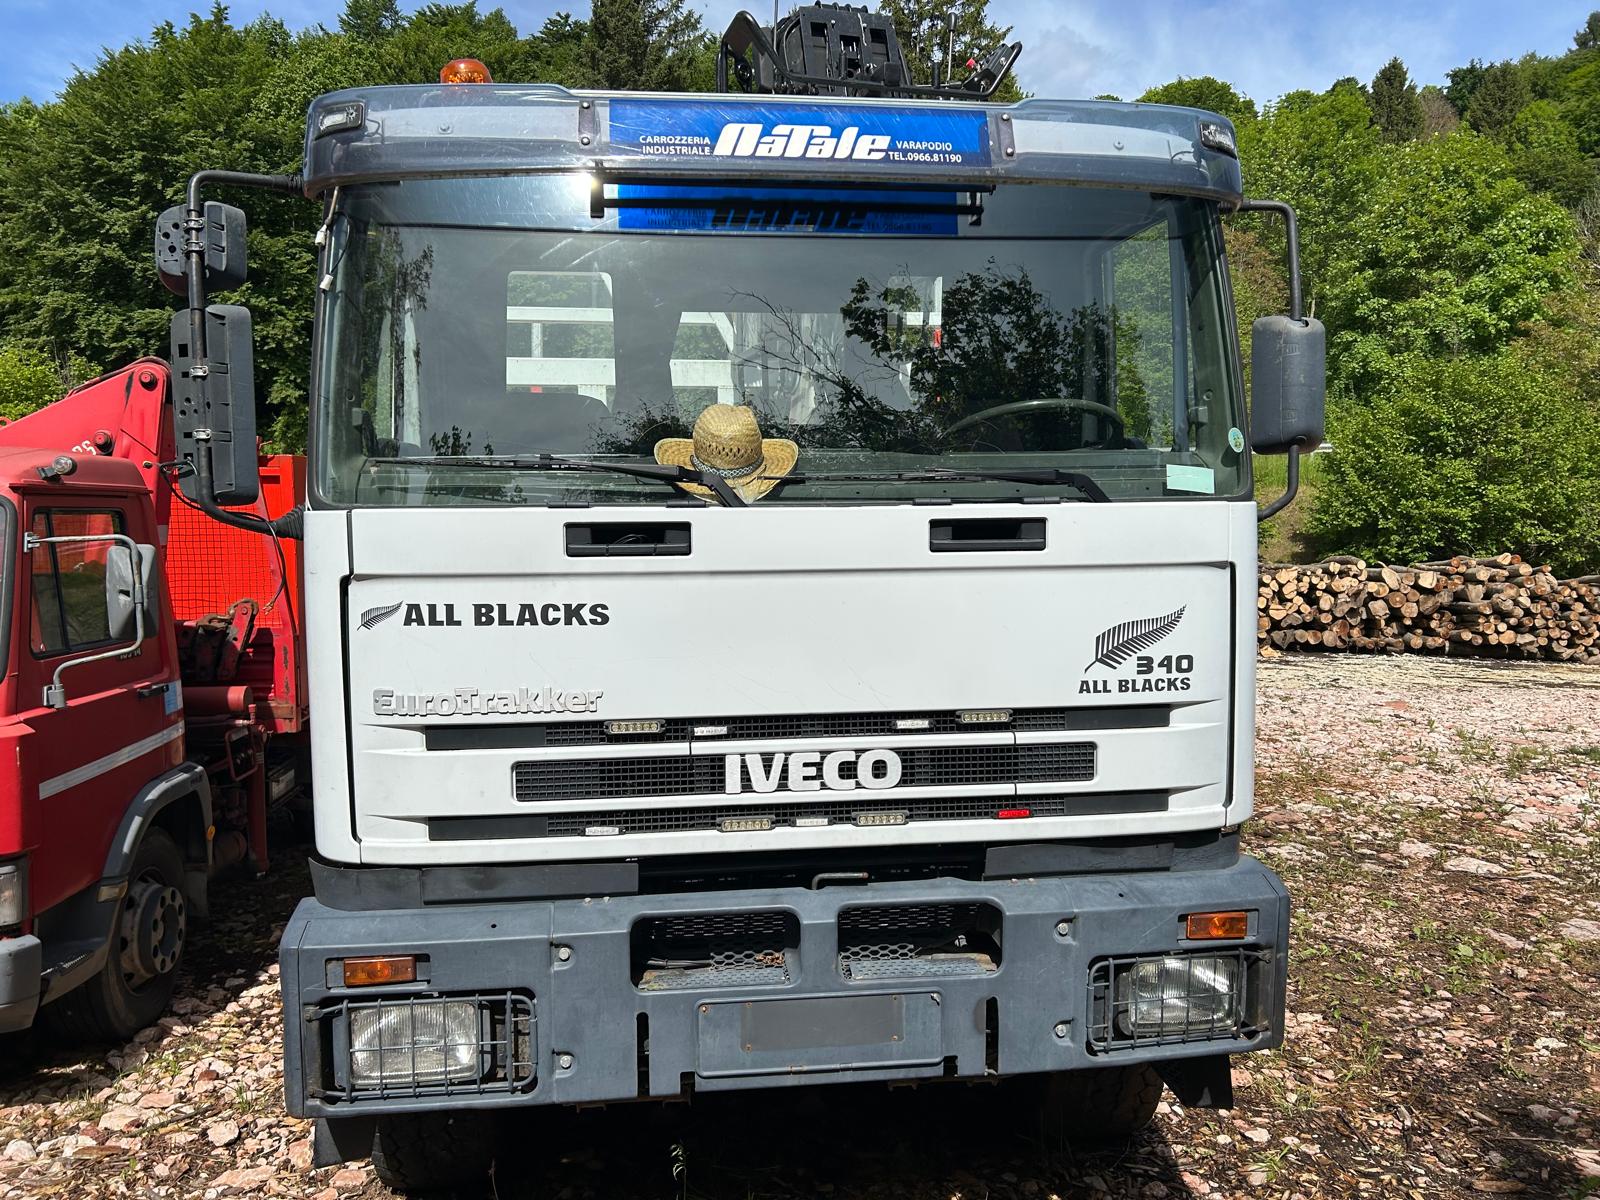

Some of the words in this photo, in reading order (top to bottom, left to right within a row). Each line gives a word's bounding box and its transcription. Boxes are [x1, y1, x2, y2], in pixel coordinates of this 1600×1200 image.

[639, 135, 711, 145] CARROZZERIA
[895, 140, 953, 152] VARAPODIO
[642, 145, 712, 156] INDUSTRIALE
[887, 151, 962, 163] TEL.0966.81190
[403, 603, 462, 627] ALL
[472, 603, 610, 627] BLACKS
[1136, 654, 1194, 676] 340
[1078, 679, 1112, 694] ALL
[1118, 677, 1191, 693] BLACKS
[373, 687, 604, 717] EuroTrakker
[725, 748, 903, 795] IVECO
